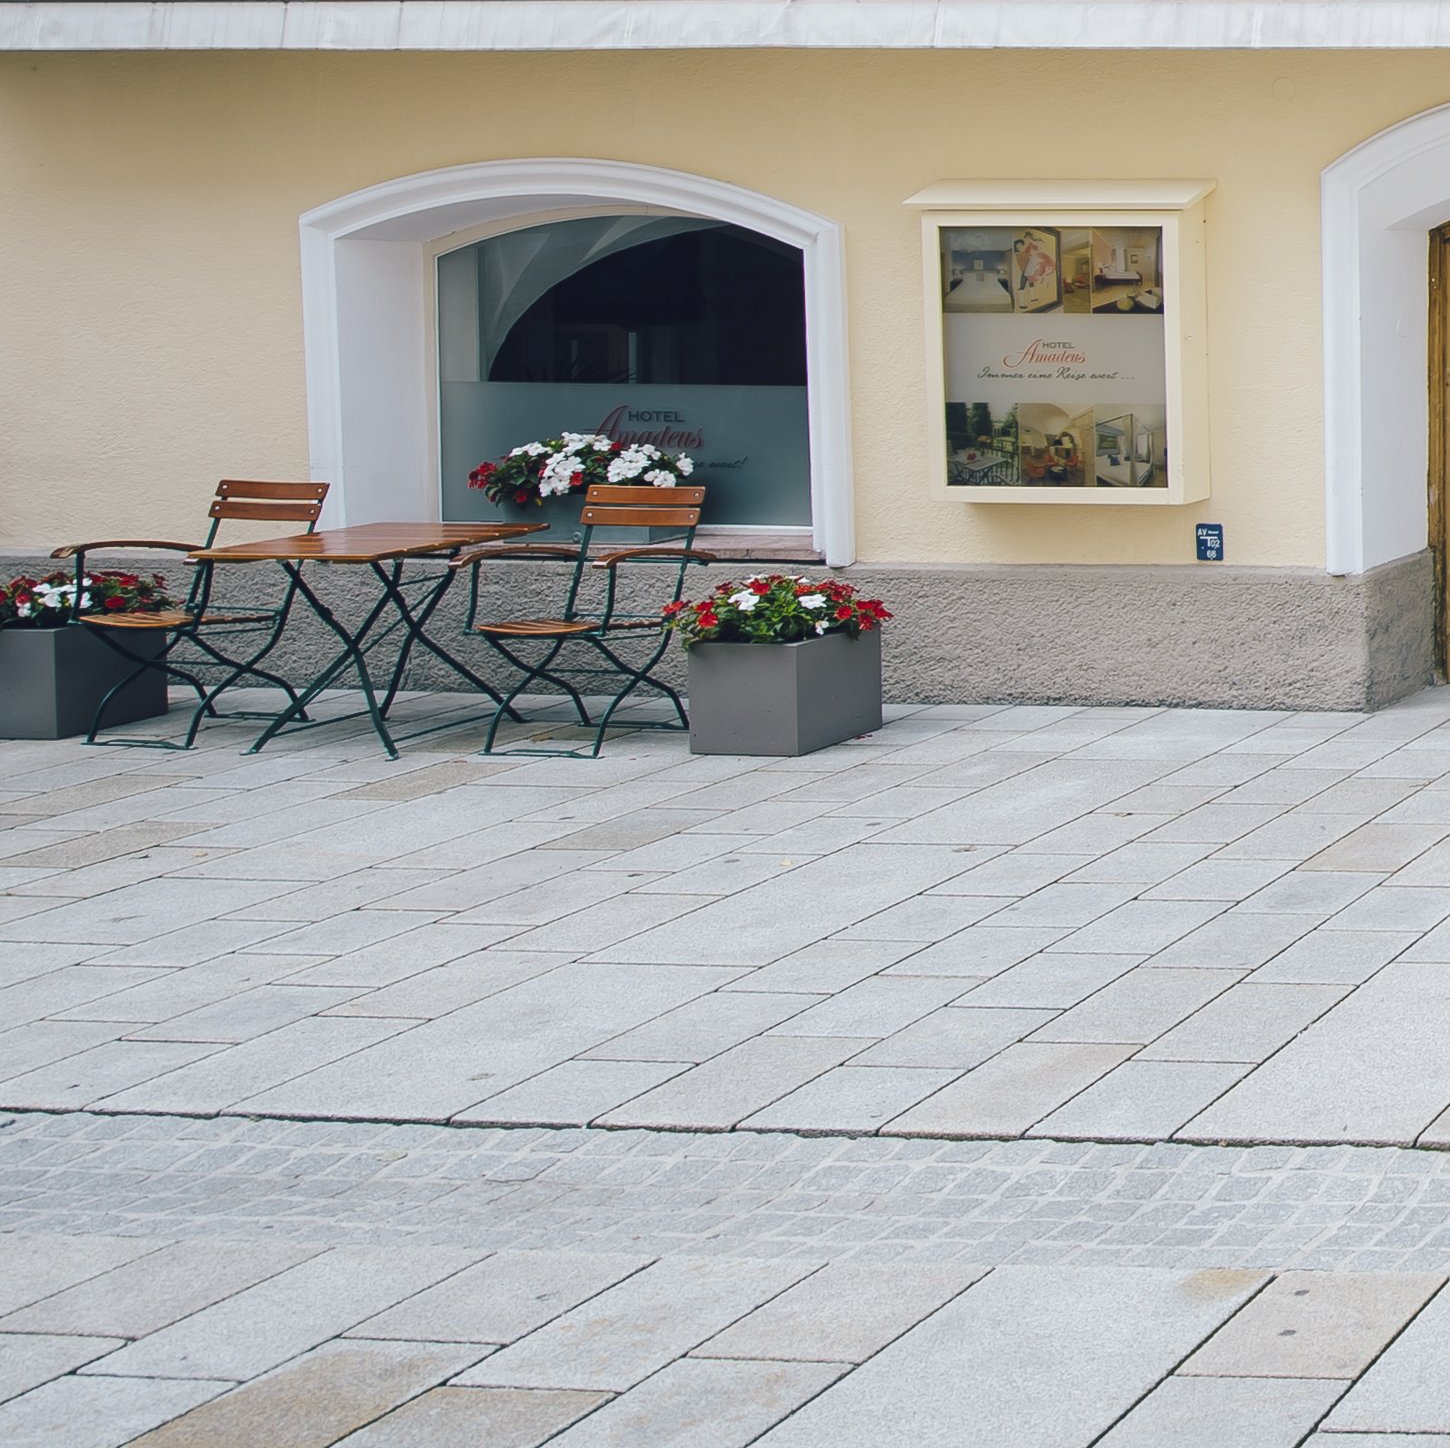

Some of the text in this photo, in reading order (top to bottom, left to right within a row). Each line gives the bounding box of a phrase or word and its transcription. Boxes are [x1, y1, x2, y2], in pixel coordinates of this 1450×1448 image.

[1042, 341, 1075, 349] HOTEL
[1003, 338, 1088, 368] Amadeus
[977, 366, 1025, 379] Immer
[1028, 370, 1053, 379] eine
[627, 410, 685, 422] HOTEL
[583, 404, 705, 449] Amadeus
